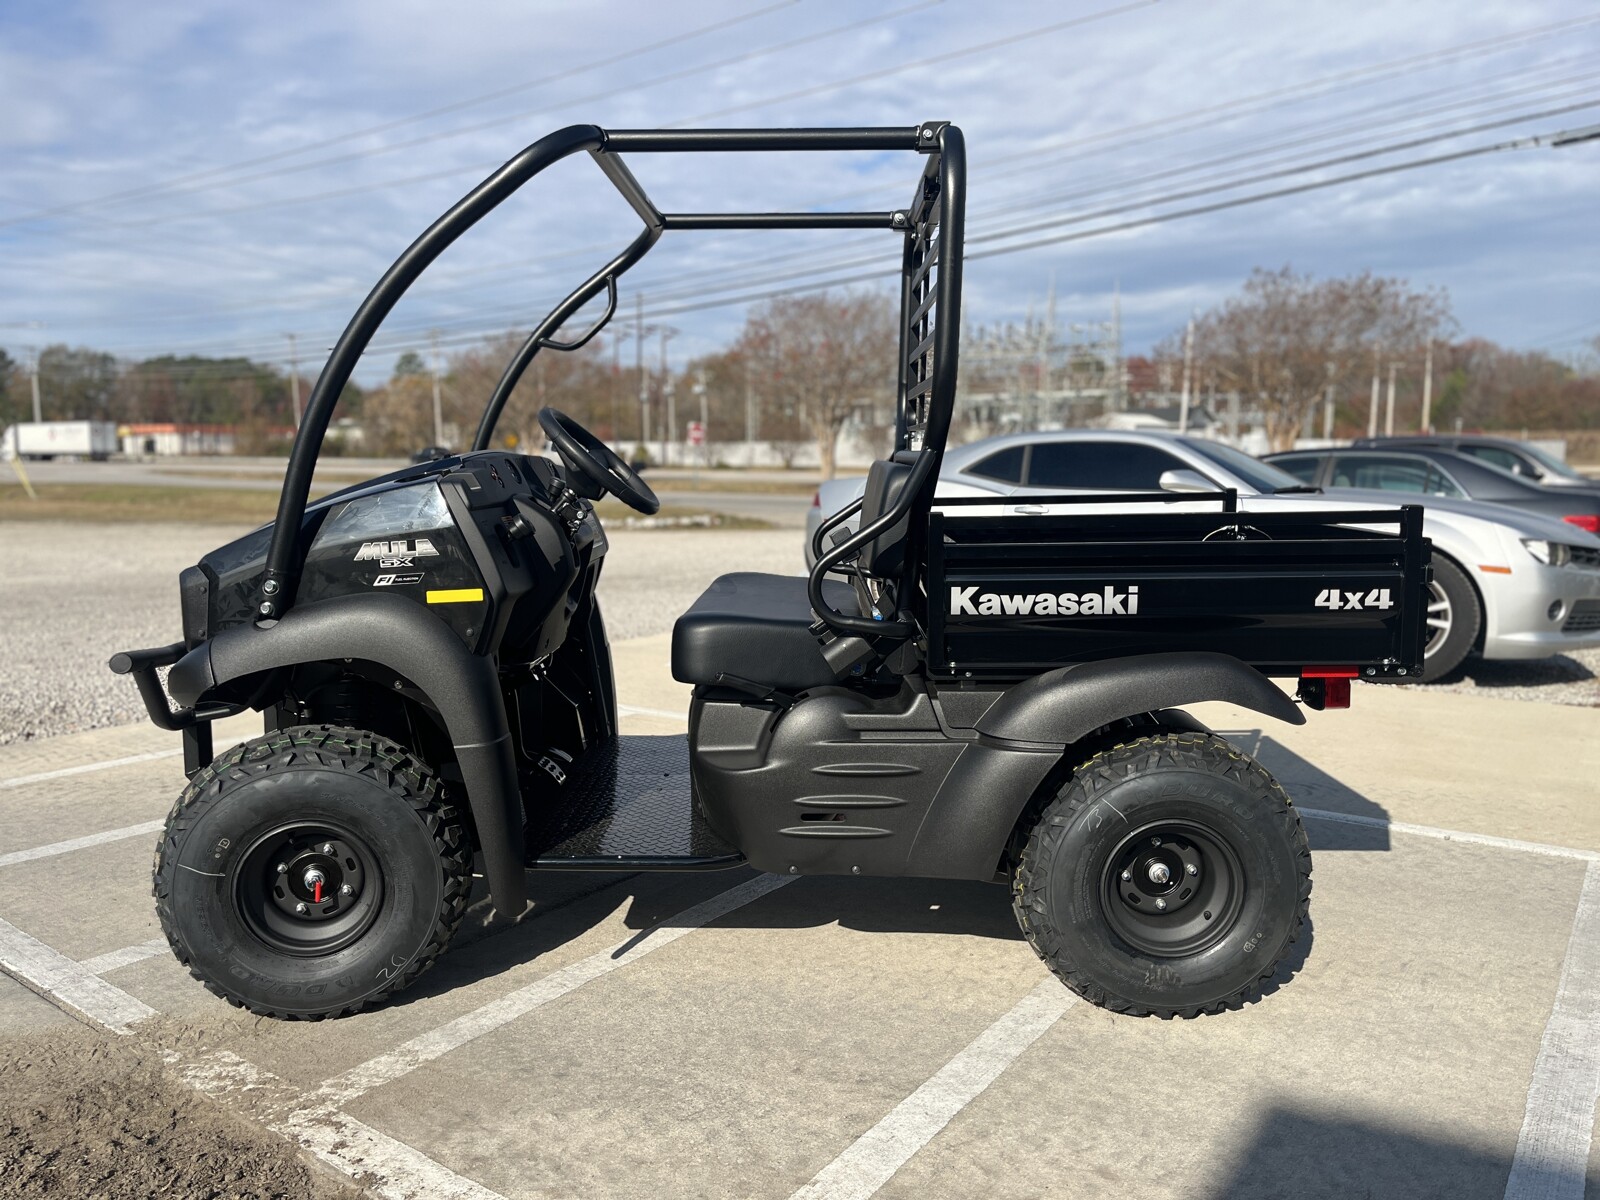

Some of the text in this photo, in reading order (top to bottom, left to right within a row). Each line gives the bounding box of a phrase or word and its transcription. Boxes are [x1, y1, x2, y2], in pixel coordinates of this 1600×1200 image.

[354, 539, 440, 561] MULE
[380, 557, 414, 568] SX
[950, 585, 1138, 615] Kawasaki
[1314, 588, 1394, 610] 4x4
